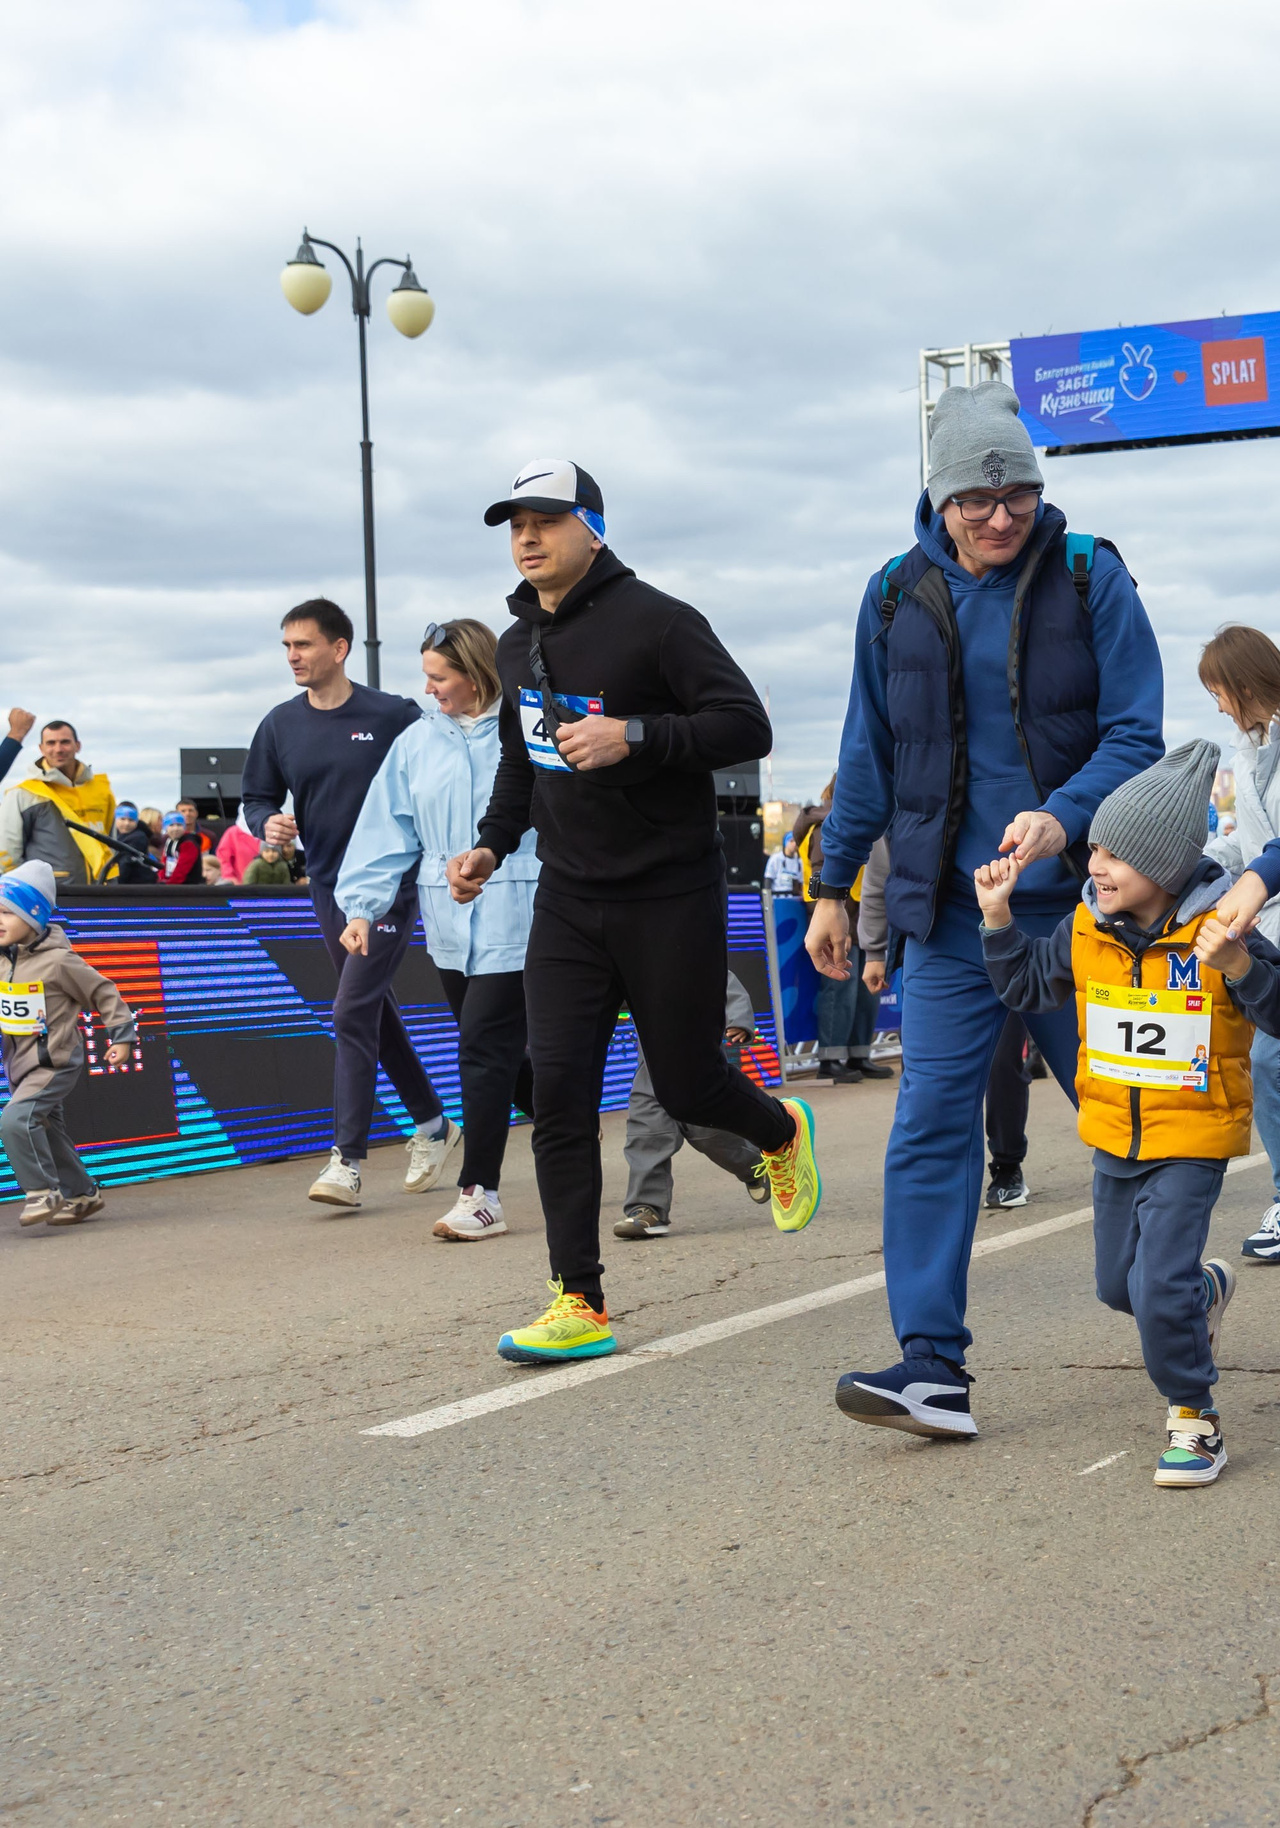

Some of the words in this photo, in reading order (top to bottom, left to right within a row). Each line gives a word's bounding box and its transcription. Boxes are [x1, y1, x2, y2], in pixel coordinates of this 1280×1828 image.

[1211, 358, 1257, 386] SPLAT
[1056, 373, 1098, 393] ЗАБЕГ
[1040, 386, 1115, 418] Кузнечики
[351, 732, 374, 741] FILA
[376, 924, 397, 933] FILA
[1095, 988, 1110, 997] 500
[1117, 1021, 1166, 1056] 12
